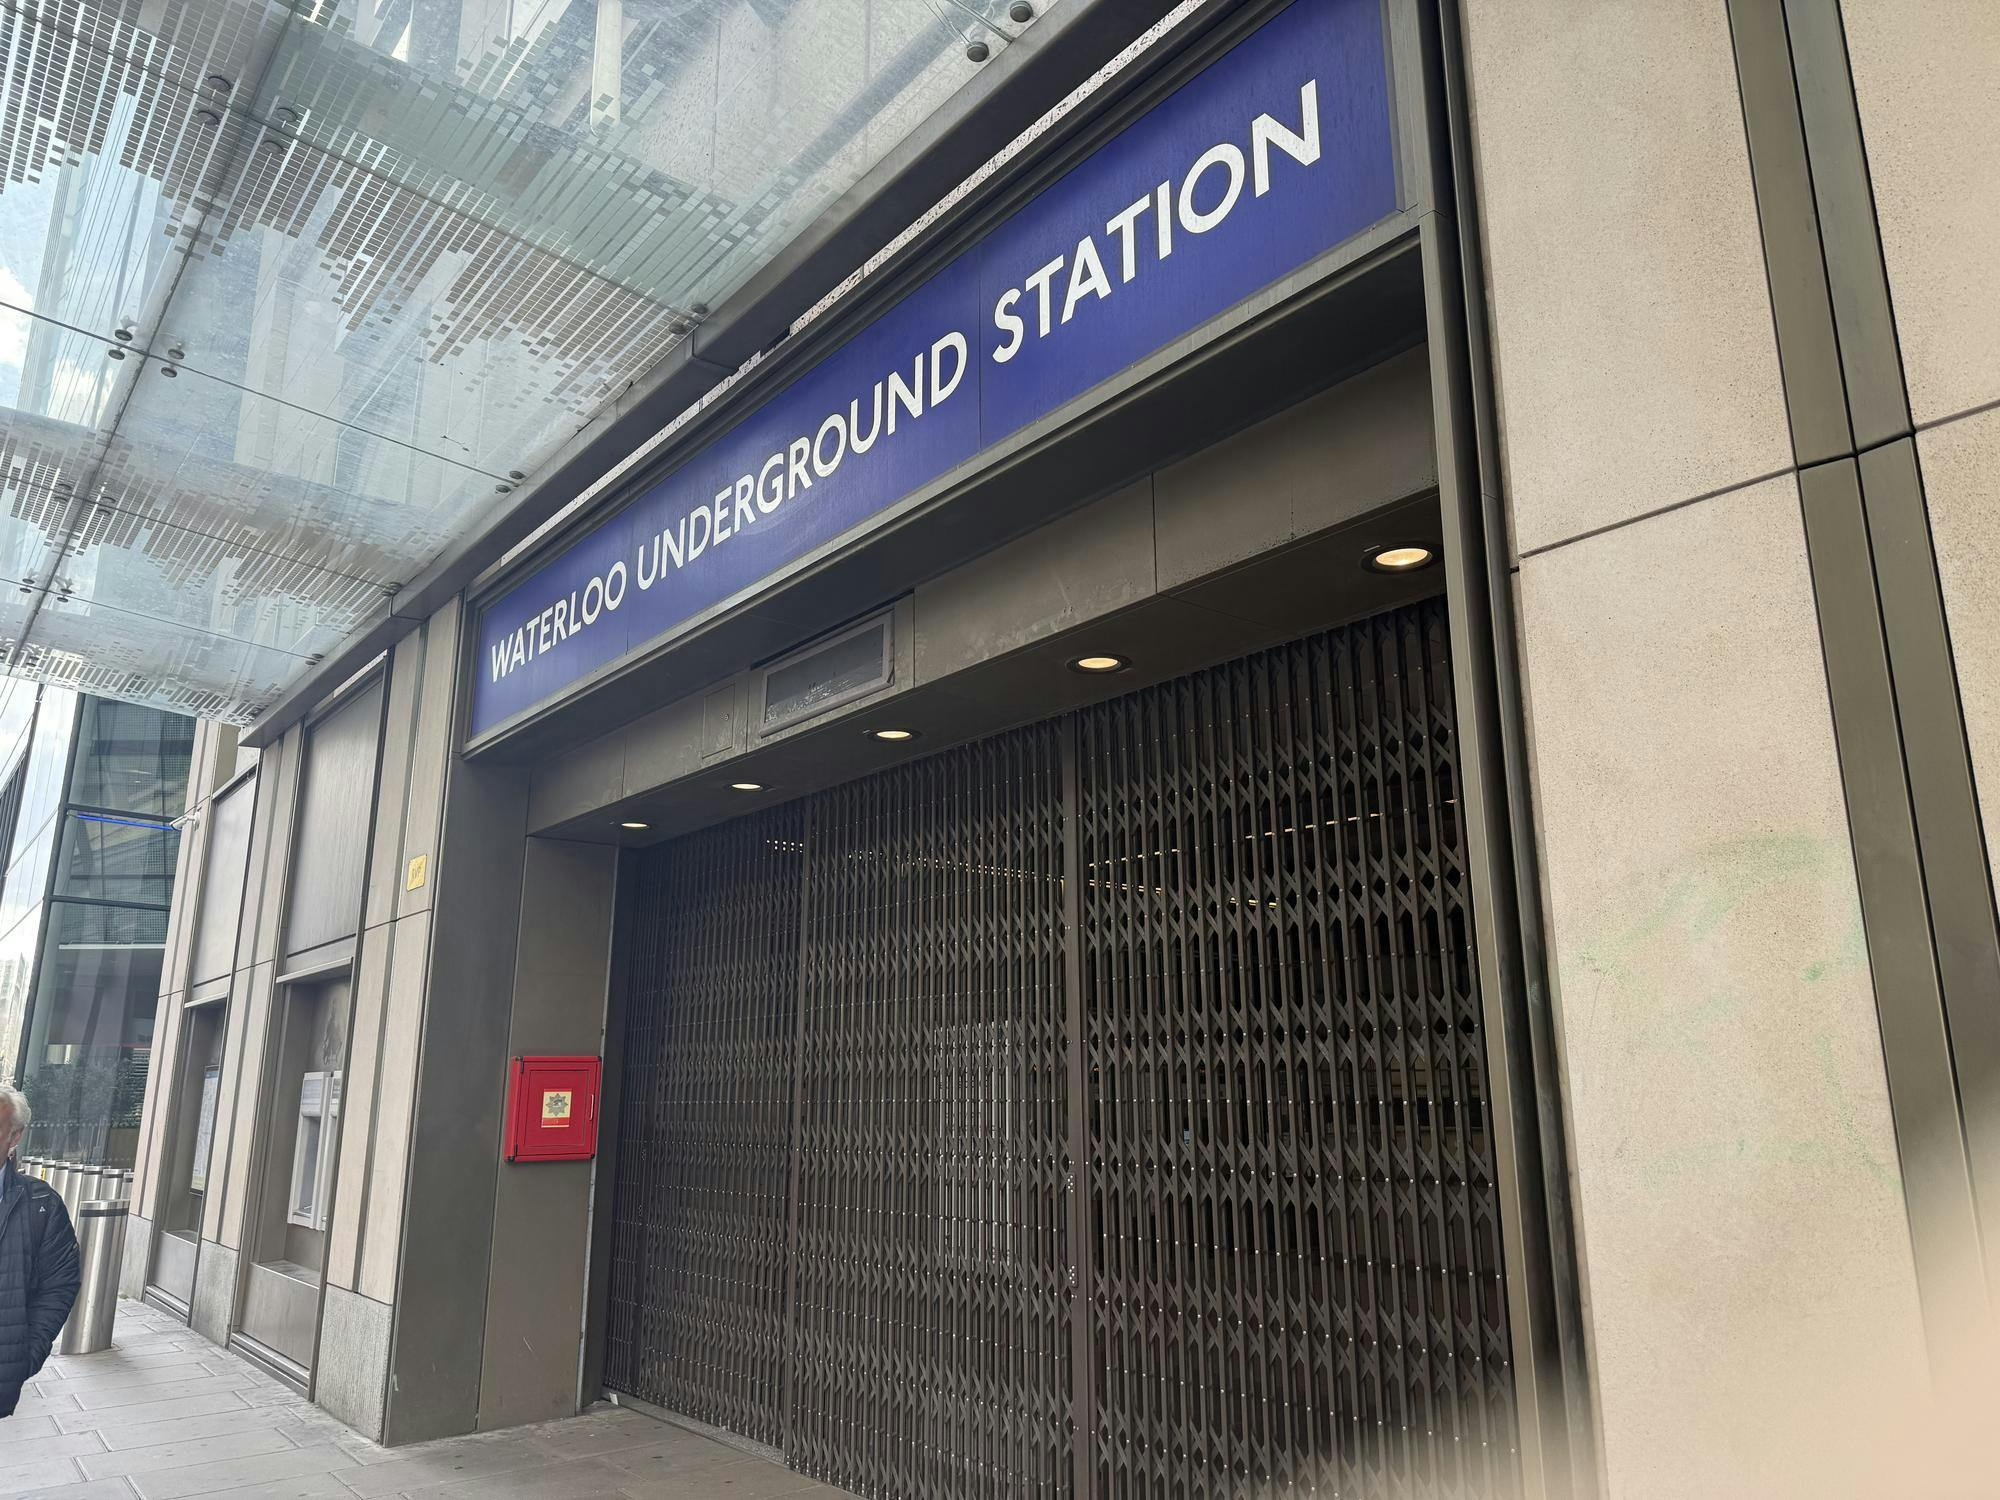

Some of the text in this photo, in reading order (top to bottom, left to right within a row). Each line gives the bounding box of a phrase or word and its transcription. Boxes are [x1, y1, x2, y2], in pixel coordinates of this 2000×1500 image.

[491, 78, 1321, 684] WATERLOO UNDERGROUND STATION
